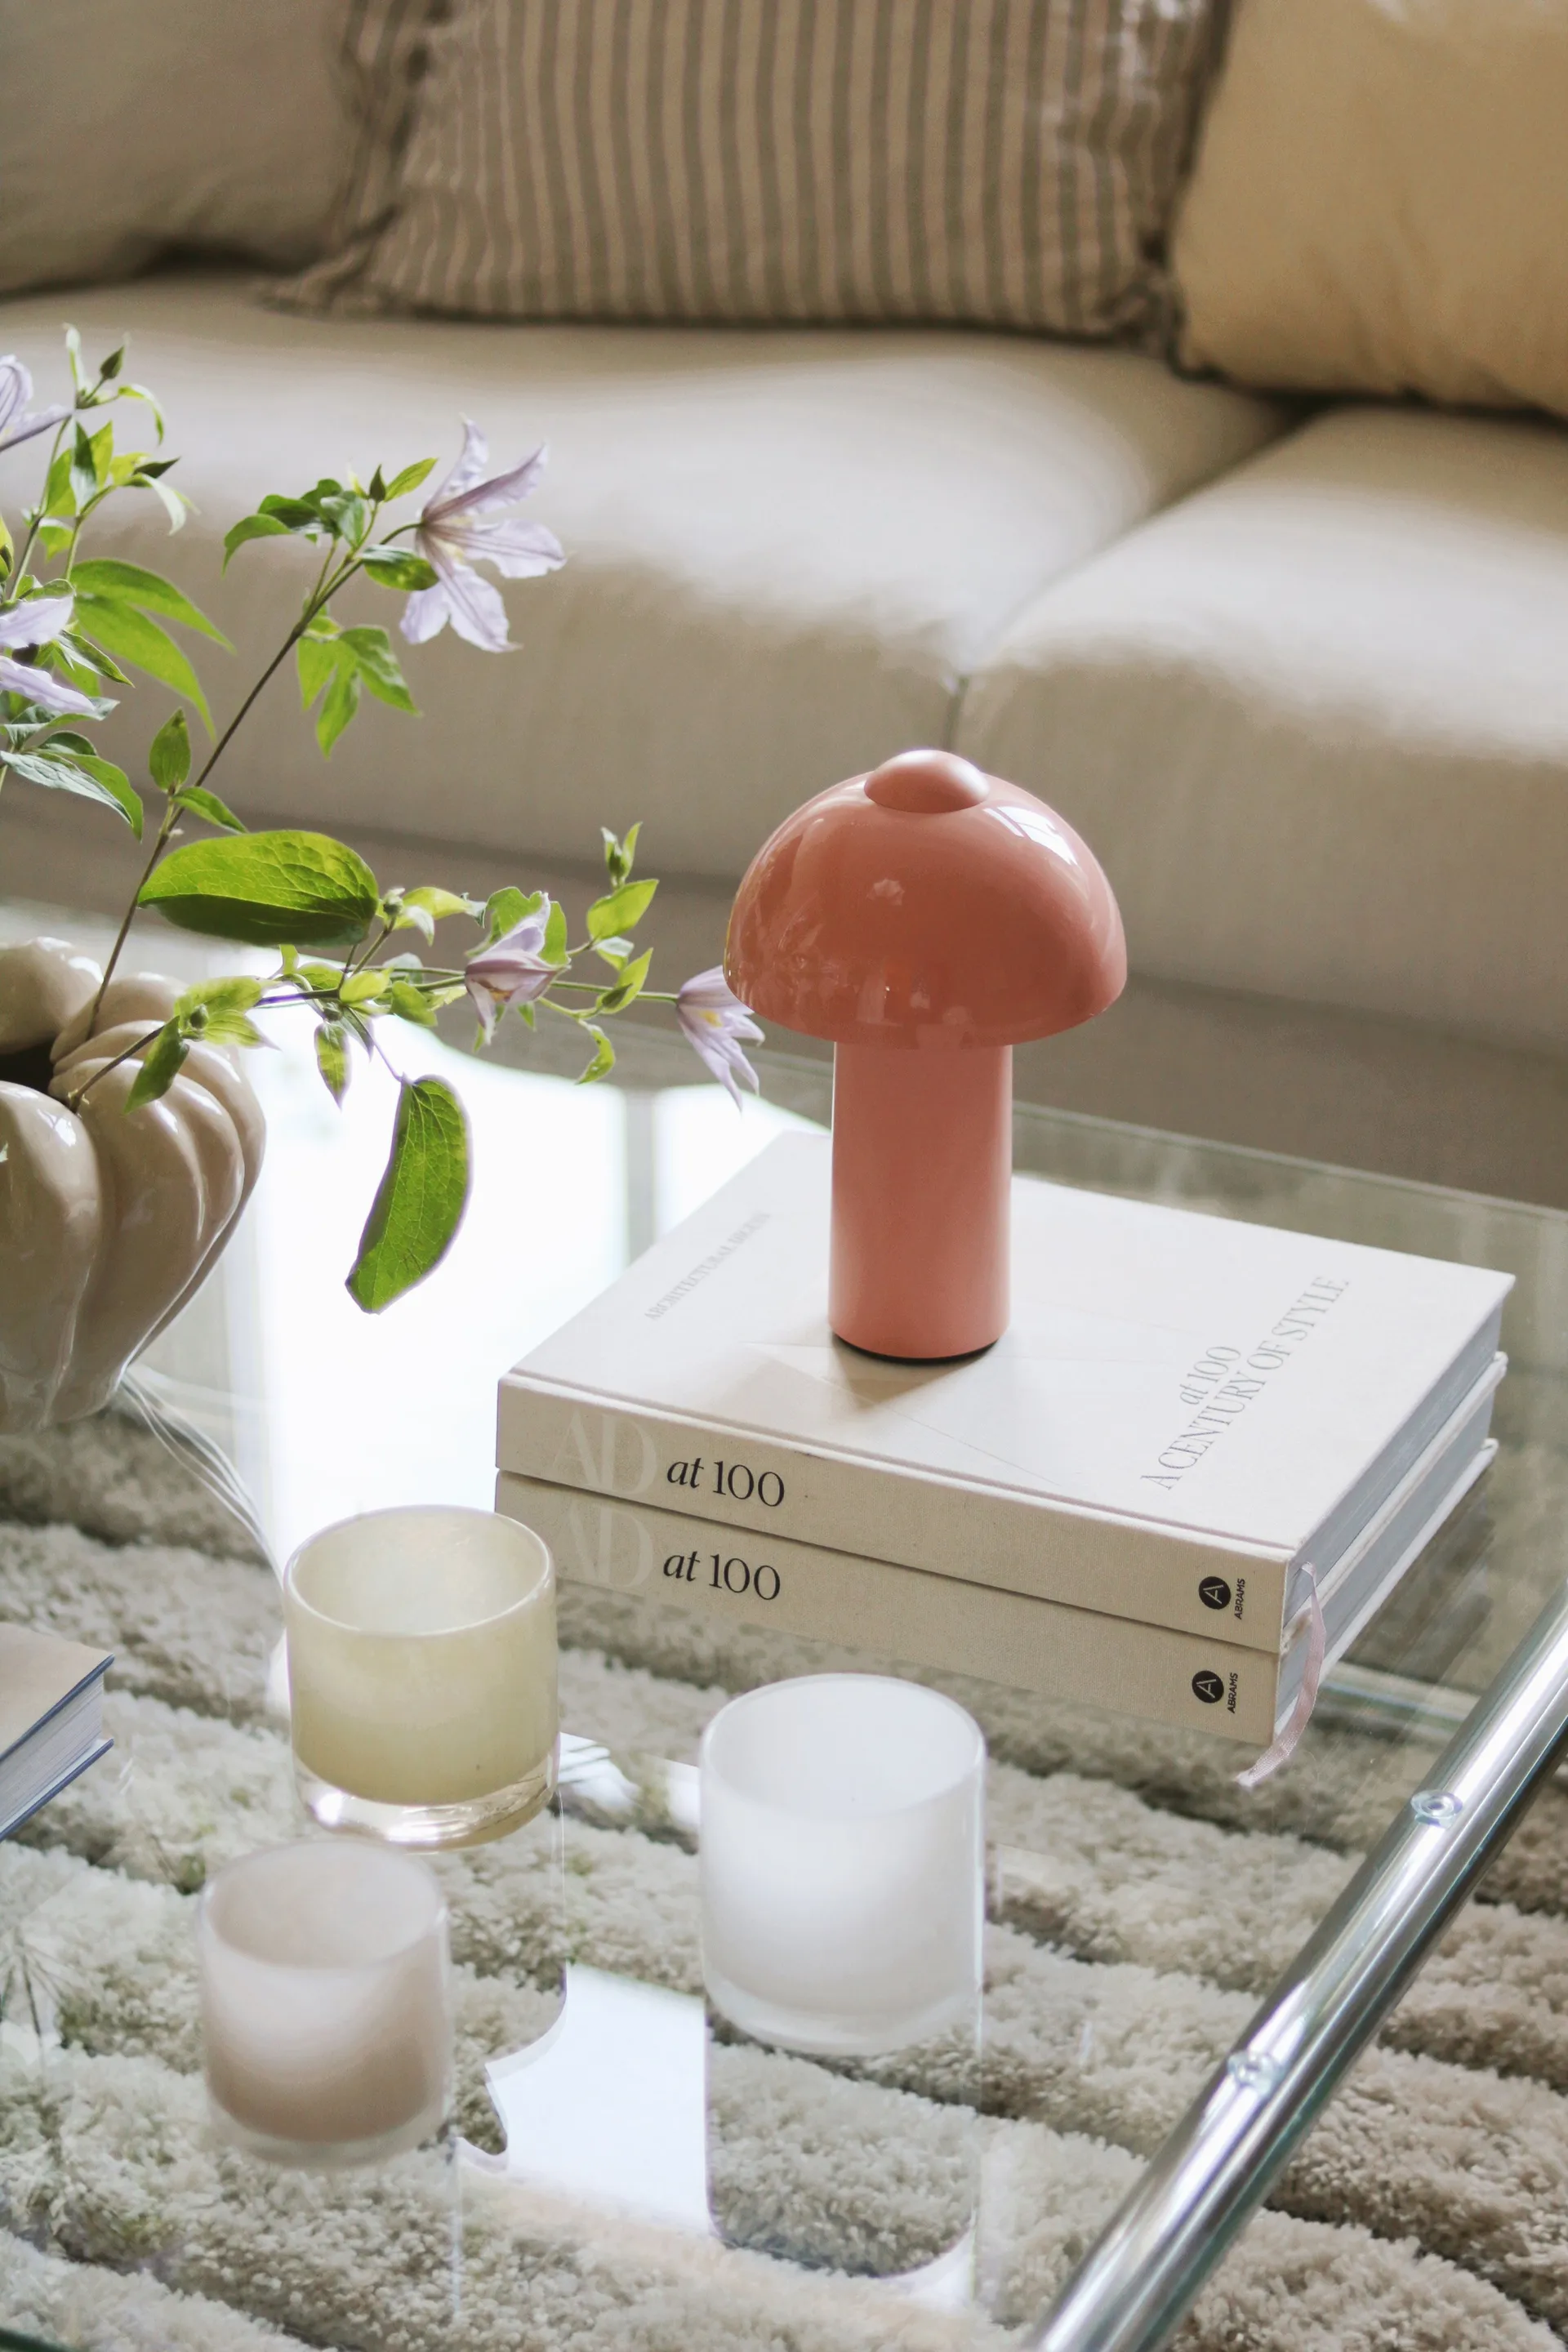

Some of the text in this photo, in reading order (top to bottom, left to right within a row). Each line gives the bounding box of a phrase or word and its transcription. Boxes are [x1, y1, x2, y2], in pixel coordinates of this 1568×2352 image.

[644, 1245, 737, 1321] ARCHITECTURAL
[1140, 1276, 1350, 1490] A CENTURY OF STYLE
[1179, 1346, 1241, 1405] at 100
[551, 1409, 785, 1507] AD at 100
[663, 1551, 701, 1582] at
[708, 1553, 781, 1601] 100
[1233, 1578, 1246, 1620] ABRAMS
[1227, 1672, 1239, 1715] ABRAMS
